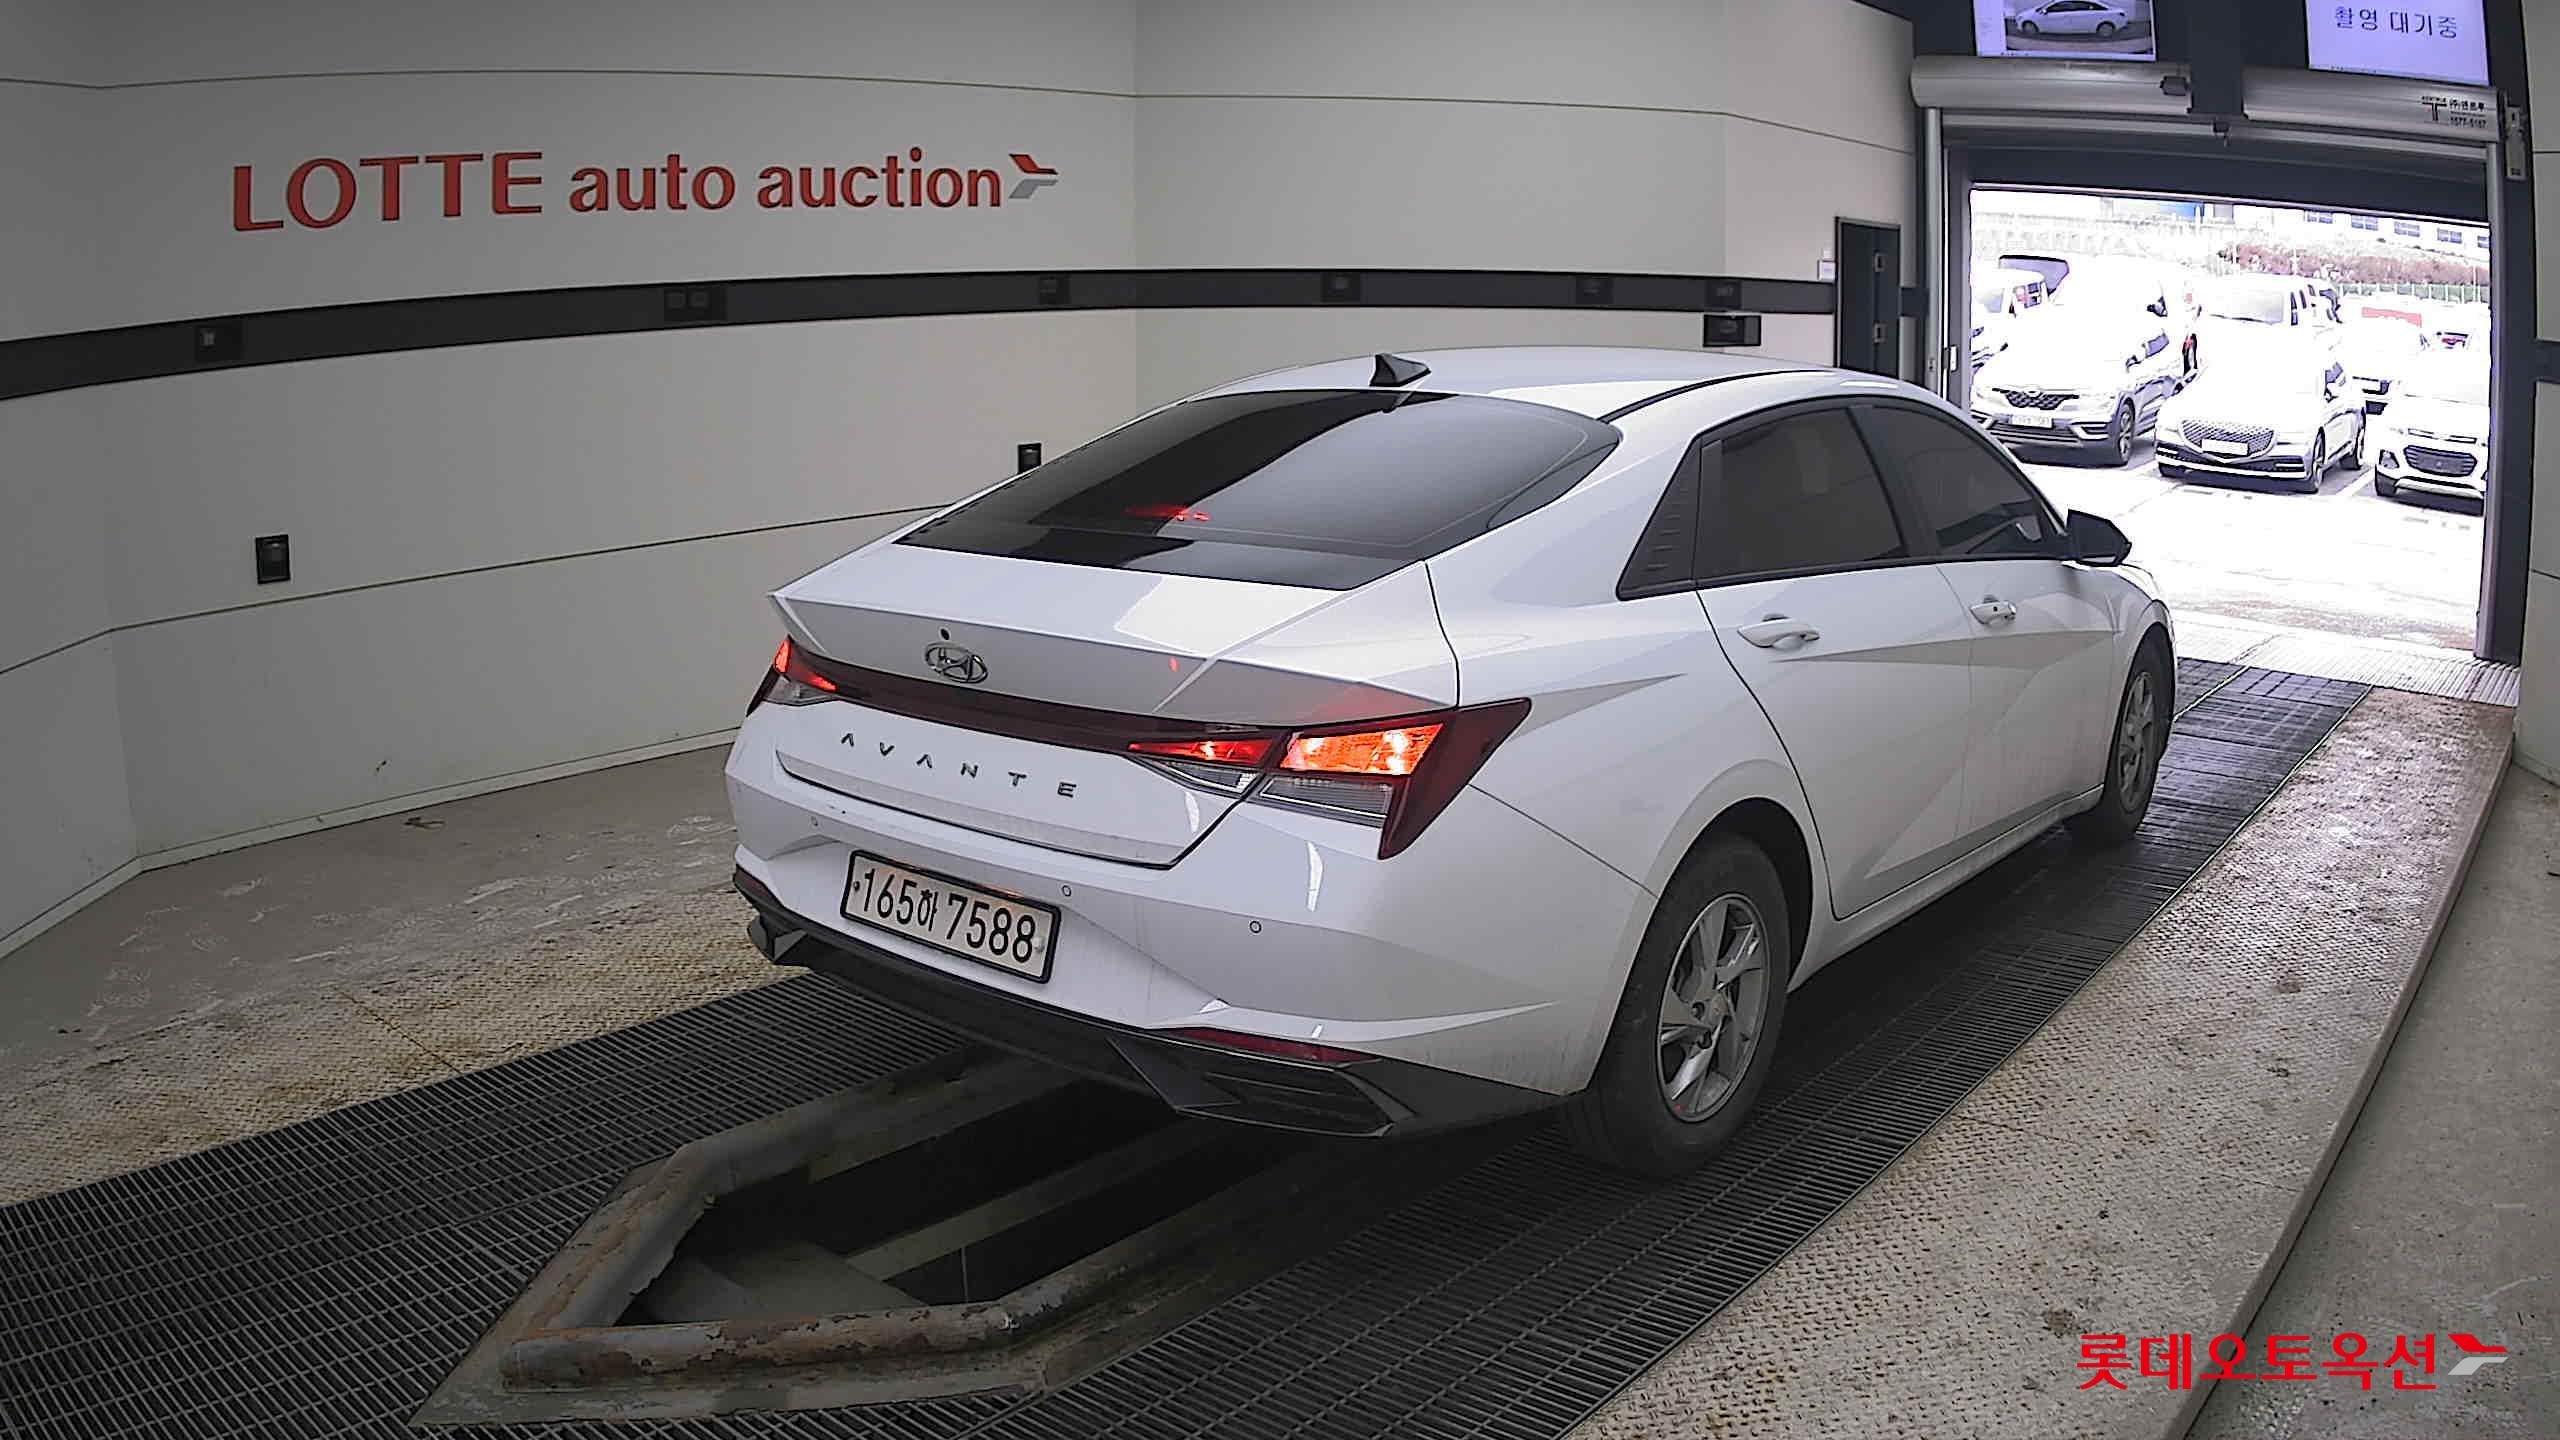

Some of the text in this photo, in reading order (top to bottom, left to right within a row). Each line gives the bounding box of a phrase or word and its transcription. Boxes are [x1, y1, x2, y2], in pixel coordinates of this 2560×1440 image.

[2334, 6, 2457, 39] 촬영 대기중
[235, 149, 1003, 232] LOTTE auto auction
[840, 731, 1078, 799] AVANTE
[863, 868, 1036, 964] 165하 7588
